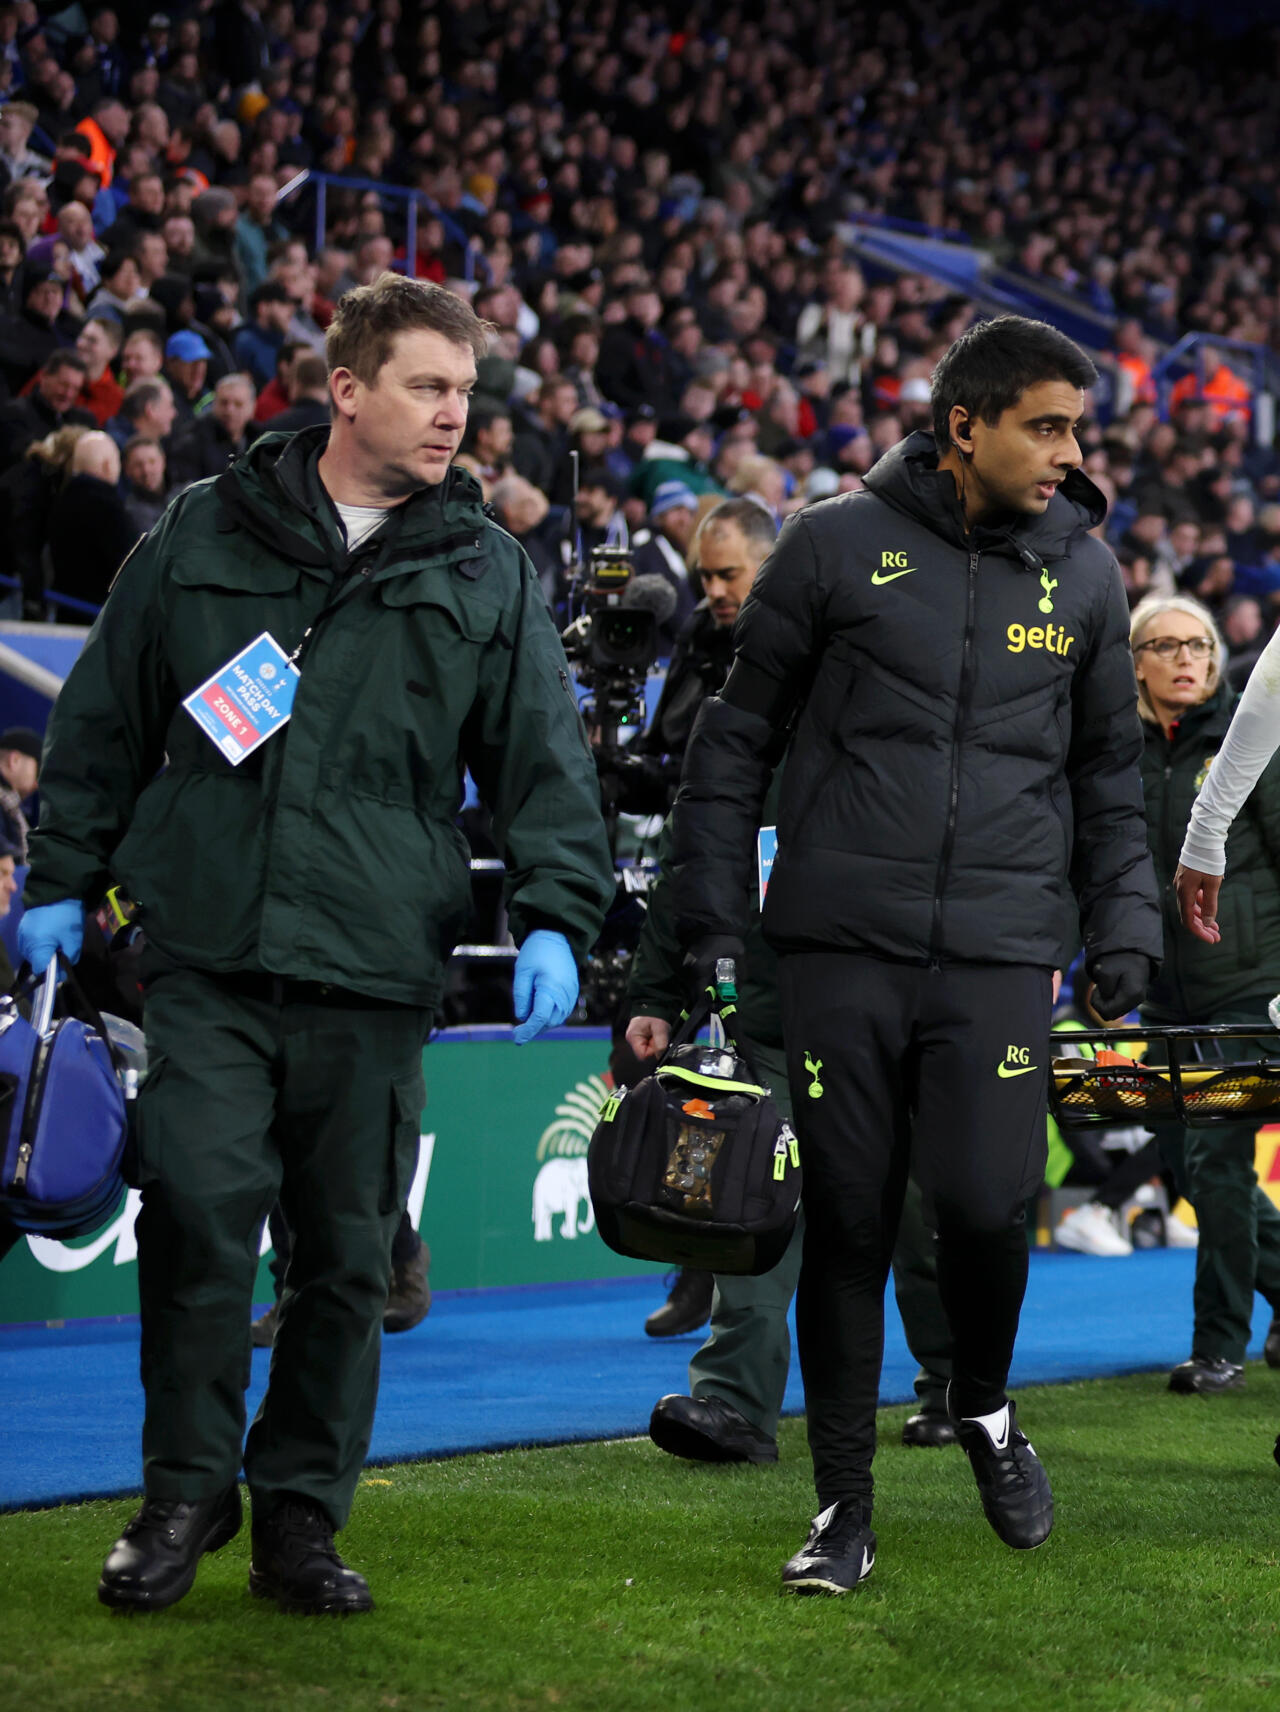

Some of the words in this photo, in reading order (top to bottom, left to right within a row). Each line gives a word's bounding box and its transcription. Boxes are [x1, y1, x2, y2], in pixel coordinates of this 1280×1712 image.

[881, 551, 908, 568] RG
[1006, 623, 1075, 657] getir
[232, 665, 265, 701] MATCH
[261, 699, 281, 719] DAY
[237, 686, 261, 712] PASS
[213, 697, 241, 729] ZONE
[239, 726, 248, 735] 1
[1006, 1044, 1030, 1065] RG
